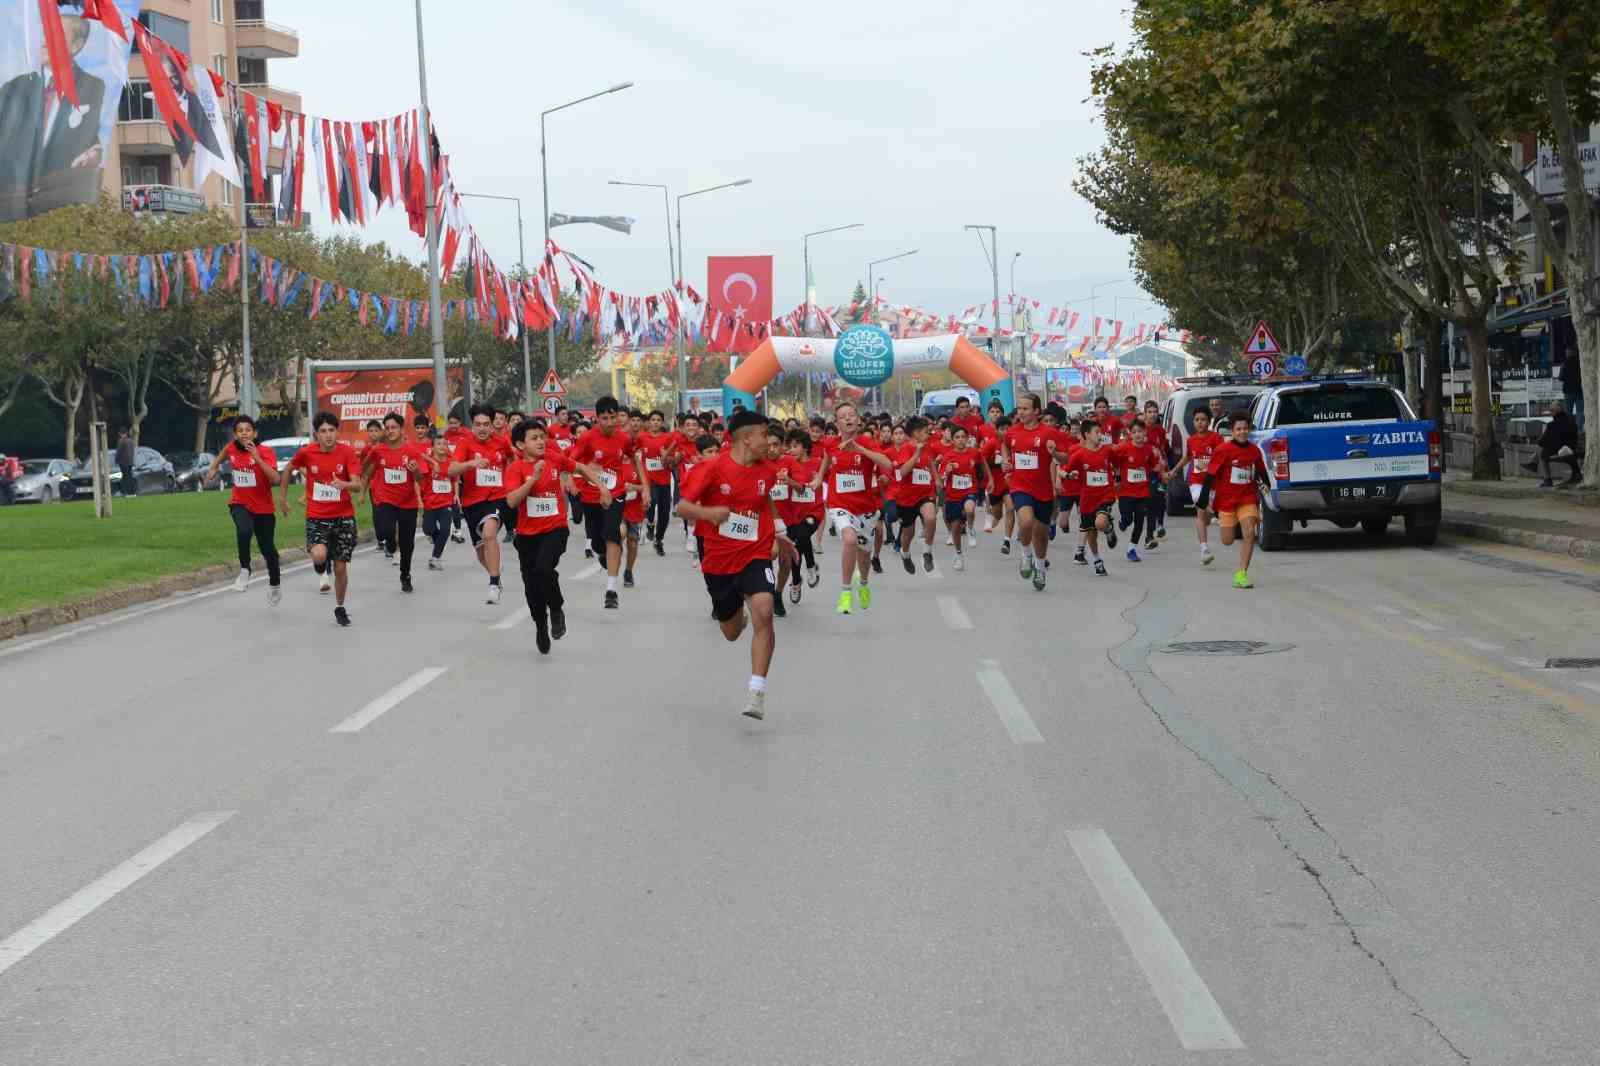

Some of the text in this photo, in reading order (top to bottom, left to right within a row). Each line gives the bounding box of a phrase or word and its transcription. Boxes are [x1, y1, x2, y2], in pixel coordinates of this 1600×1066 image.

[843, 359, 886, 369] NİLÜFER
[1255, 362, 1271, 374] 30
[330, 391, 415, 404] CUMHURİYET DEMEK
[344, 405, 403, 417] DEMOKRASİ
[547, 400, 560, 410] 30
[1313, 411, 1353, 420] NİLÜFER
[1371, 431, 1425, 445] ZABITA
[730, 522, 749, 536] 766
